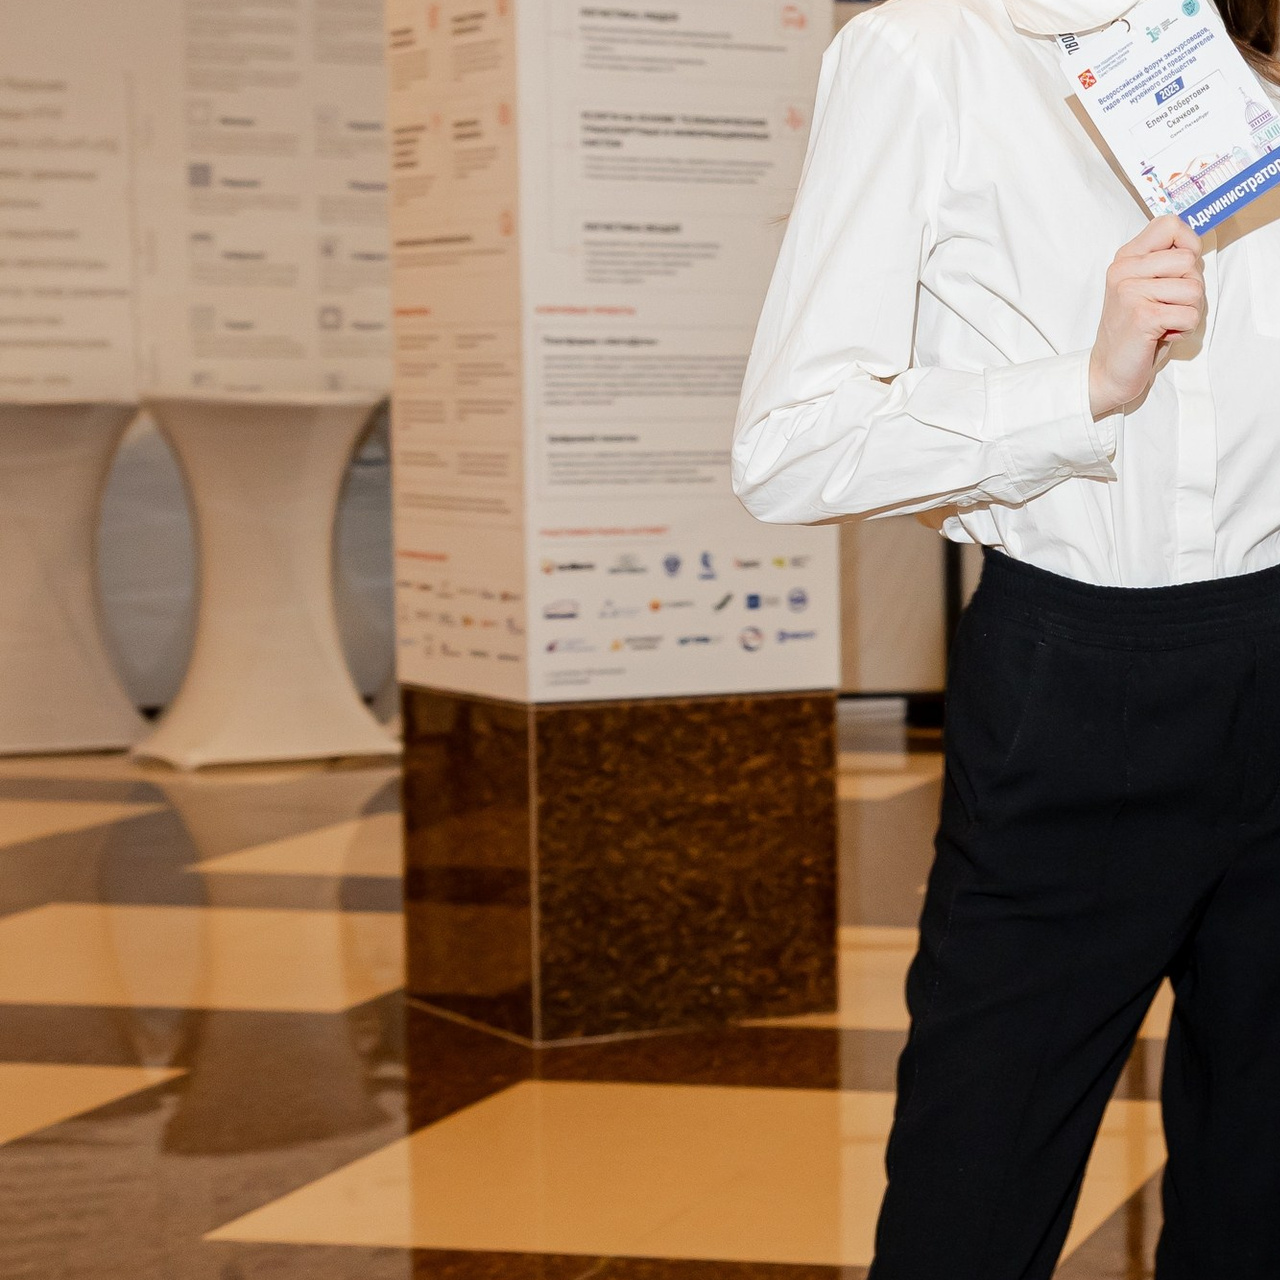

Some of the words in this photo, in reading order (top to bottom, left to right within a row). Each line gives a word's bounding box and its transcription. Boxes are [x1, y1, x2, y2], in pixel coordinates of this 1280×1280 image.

[1098, 70, 1144, 105] Всероссийский
[1143, 57, 1163, 74] форум
[1164, 26, 1210, 60] экскурсоводов,
[1102, 69, 1163, 113] гидов-переводчиков
[1167, 32, 1215, 69] представителей
[1129, 81, 1161, 105] музейного
[1160, 55, 1197, 83] сообщества
[1145, 111, 1169, 129] Елена
[1167, 83, 1211, 114] Робертовна
[1159, 81, 1180, 100] 2025
[1166, 104, 1200, 129] Скачкова
